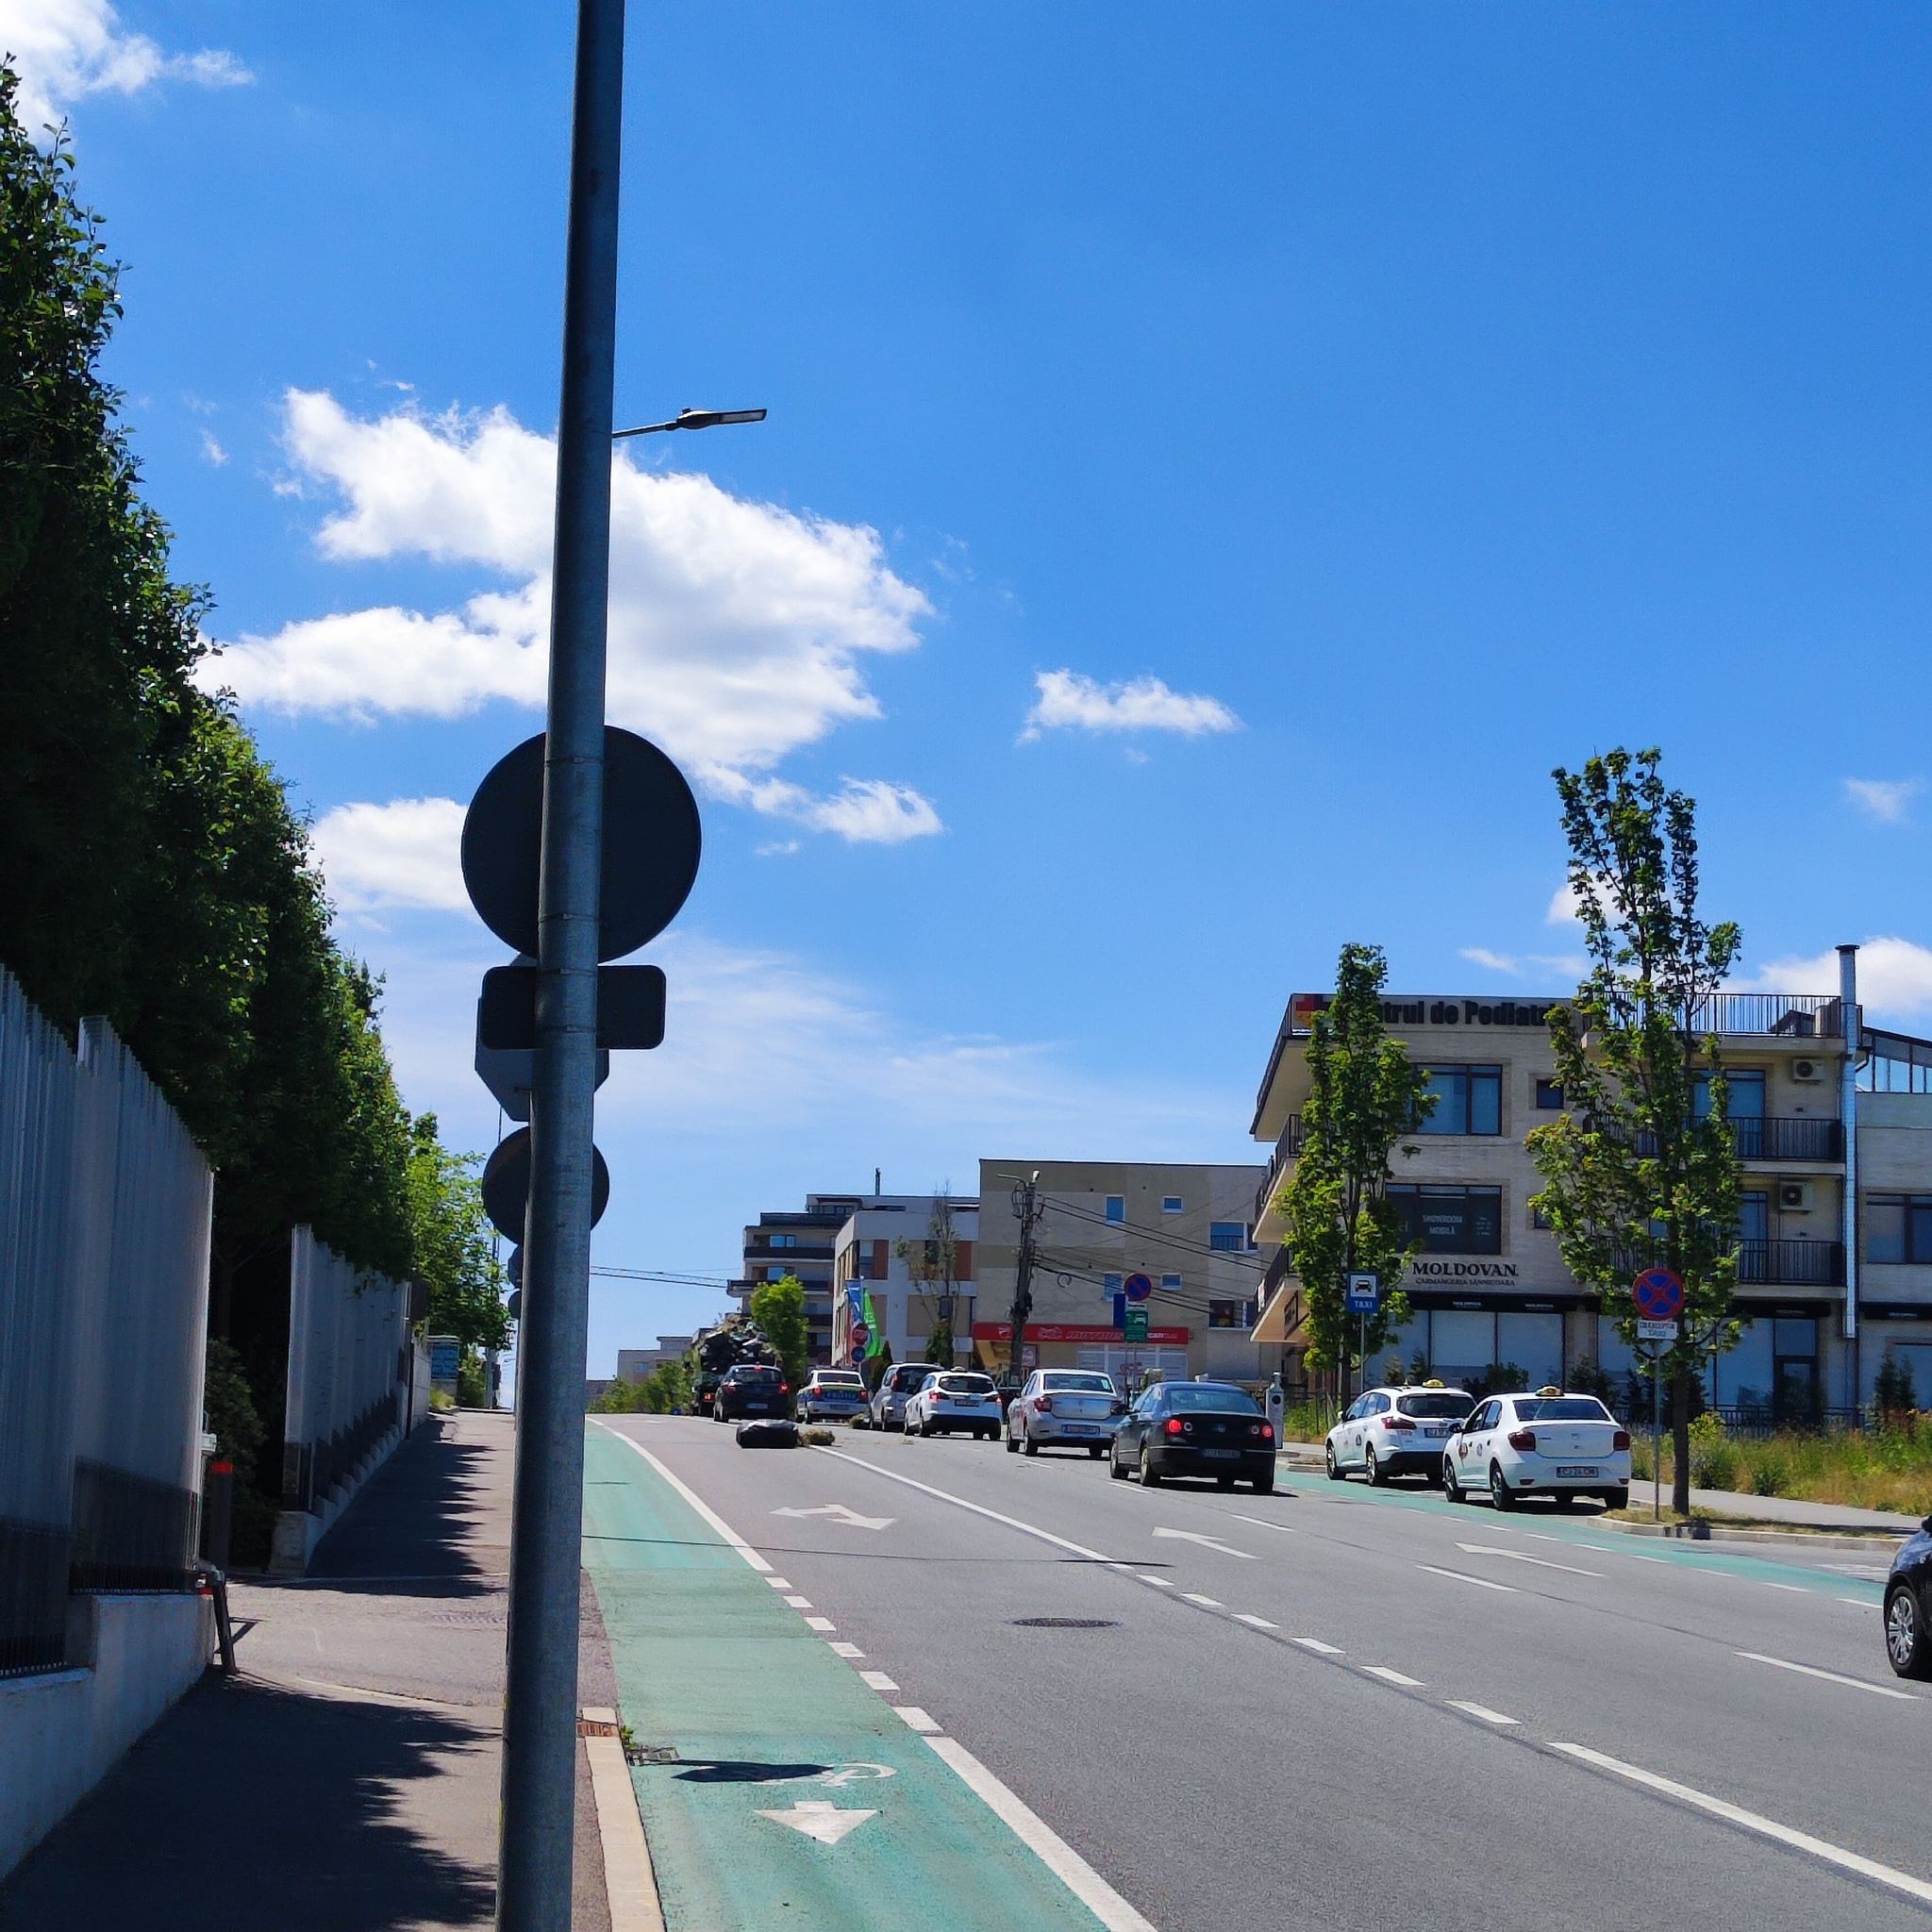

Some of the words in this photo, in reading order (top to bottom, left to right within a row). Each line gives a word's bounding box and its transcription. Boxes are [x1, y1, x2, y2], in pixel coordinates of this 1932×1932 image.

[1430, 1001, 1458, 1024] de
[1464, 999, 1556, 1026] Pediatr
[1422, 1214, 1462, 1224] SHOWROOM
[1412, 1261, 1517, 1276] MOLDOVAN
[1354, 1300, 1373, 1308] TAXI
